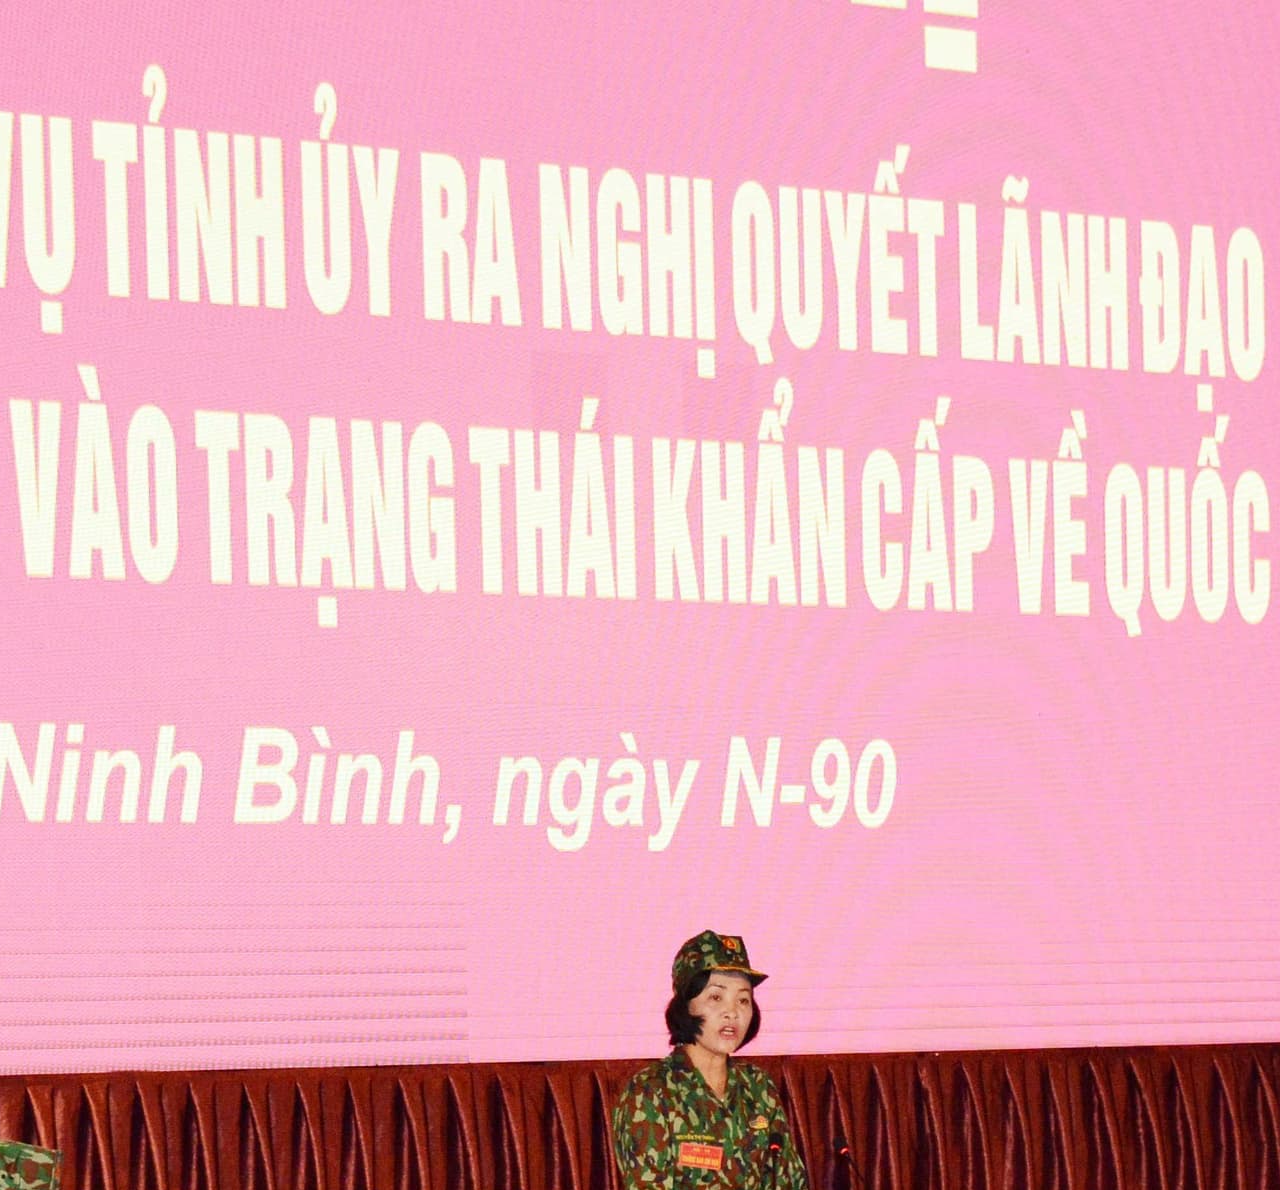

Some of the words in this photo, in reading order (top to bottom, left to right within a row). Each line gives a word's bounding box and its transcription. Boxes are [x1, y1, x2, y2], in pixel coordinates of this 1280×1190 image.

[90, 62, 288, 311] TỈNH
[299, 80, 401, 318] ỦY
[418, 150, 524, 328] RA
[537, 161, 718, 380] NGHỊ
[729, 142, 946, 367] QUYẾT
[956, 174, 1131, 372] LÃNH
[1137, 218, 1267, 414] ĐẠO
[7, 362, 181, 586] VÀO
[192, 408, 459, 630] TRẠNG
[466, 395, 639, 602] THÁI
[650, 375, 848, 610] KHẨN
[859, 394, 996, 614] CẤP
[1006, 408, 1092, 618] VỀ
[1103, 413, 1272, 639] QUỐC
[232, 724, 464, 846] Bình,
[491, 732, 702, 853] ngày
[719, 734, 899, 830] N-90
